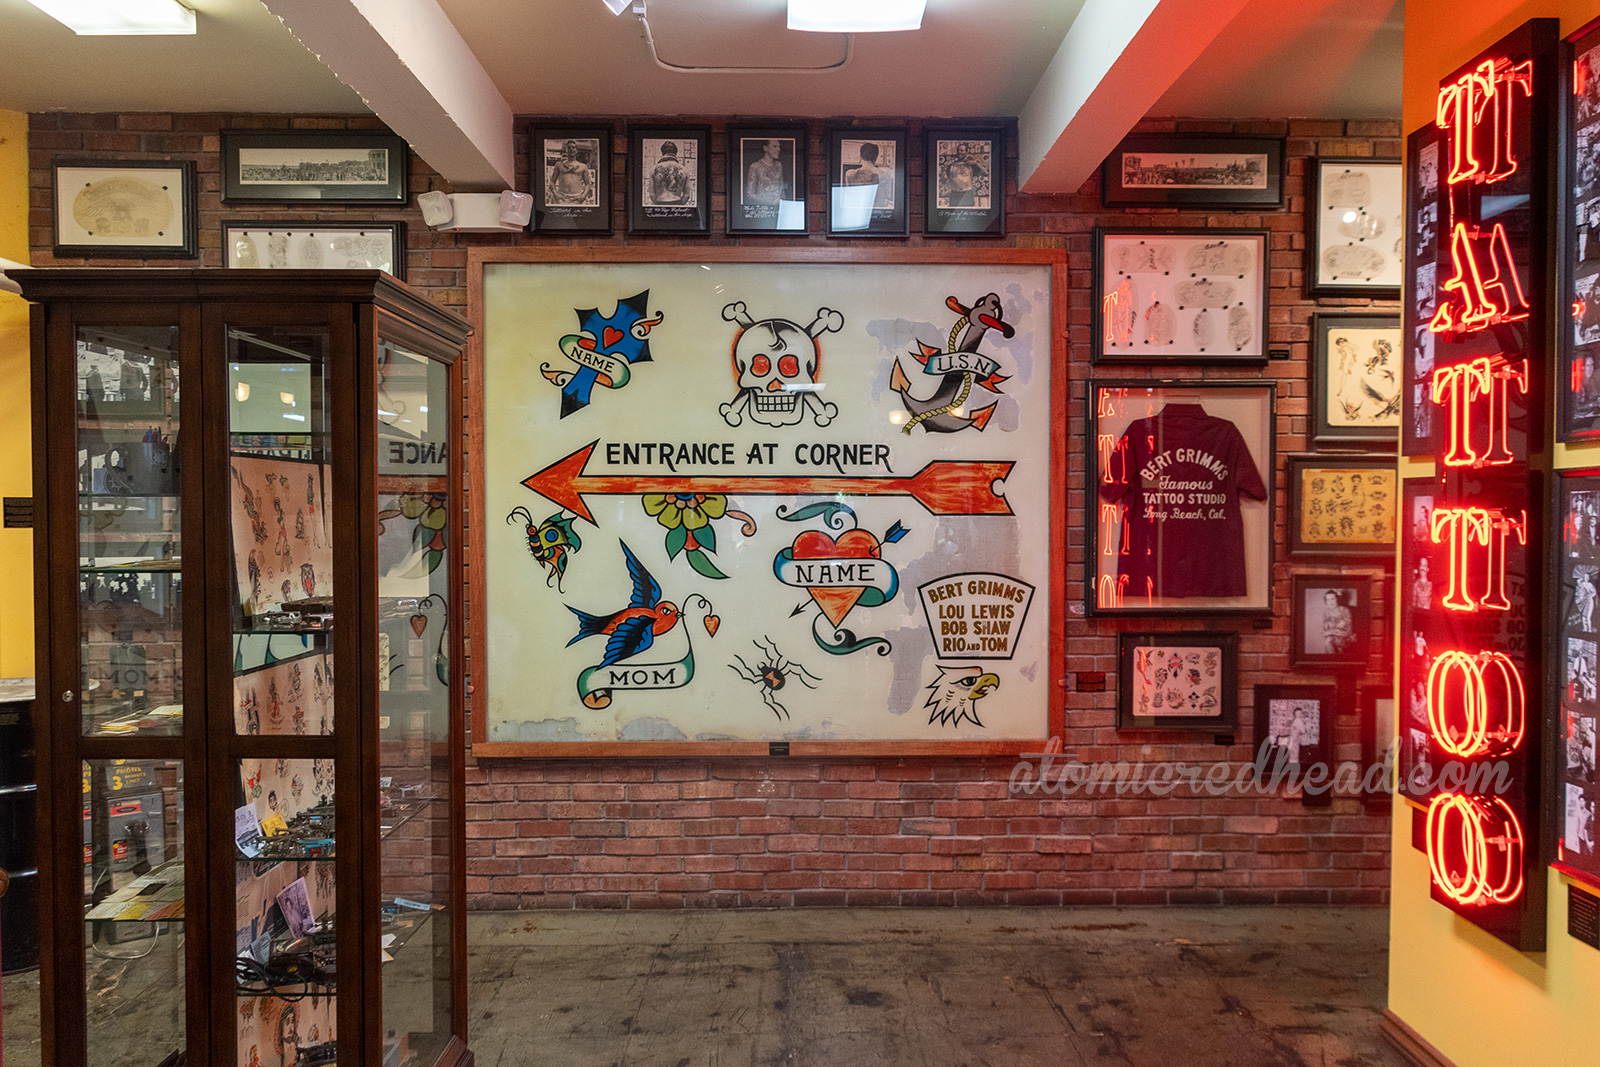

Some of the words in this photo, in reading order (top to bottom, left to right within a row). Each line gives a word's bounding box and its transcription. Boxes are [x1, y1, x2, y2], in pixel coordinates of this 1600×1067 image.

[570, 346, 615, 373] NAME
[606, 443, 735, 472] ENTRANCE
[746, 443, 778, 465] AT
[795, 443, 894, 474] CORNER
[1140, 450, 1172, 481] BERT
[1159, 475, 1213, 490] Famous
[1427, 58, 1505, 906] TATTOO
[1142, 492, 1185, 504] TATTOO
[1188, 493, 1227, 505] STUDIO
[1170, 507, 1206, 521] Beach,
[1208, 508, 1226, 520] Cal.
[795, 564, 875, 584] NAME
[927, 582, 963, 604] BERT
[968, 580, 1026, 604] GRIMMS
[939, 604, 965, 619] LOU
[971, 604, 1015, 619] LEWIS
[941, 621, 968, 636] BOB
[973, 621, 1012, 636] SHAW
[943, 637, 966, 652] RIO
[966, 643, 980, 651] AND
[980, 637, 1008, 652] TOM
[609, 668, 676, 685] MOM
[115, 766, 142, 775] PHONE
[112, 775, 123, 790] 3
